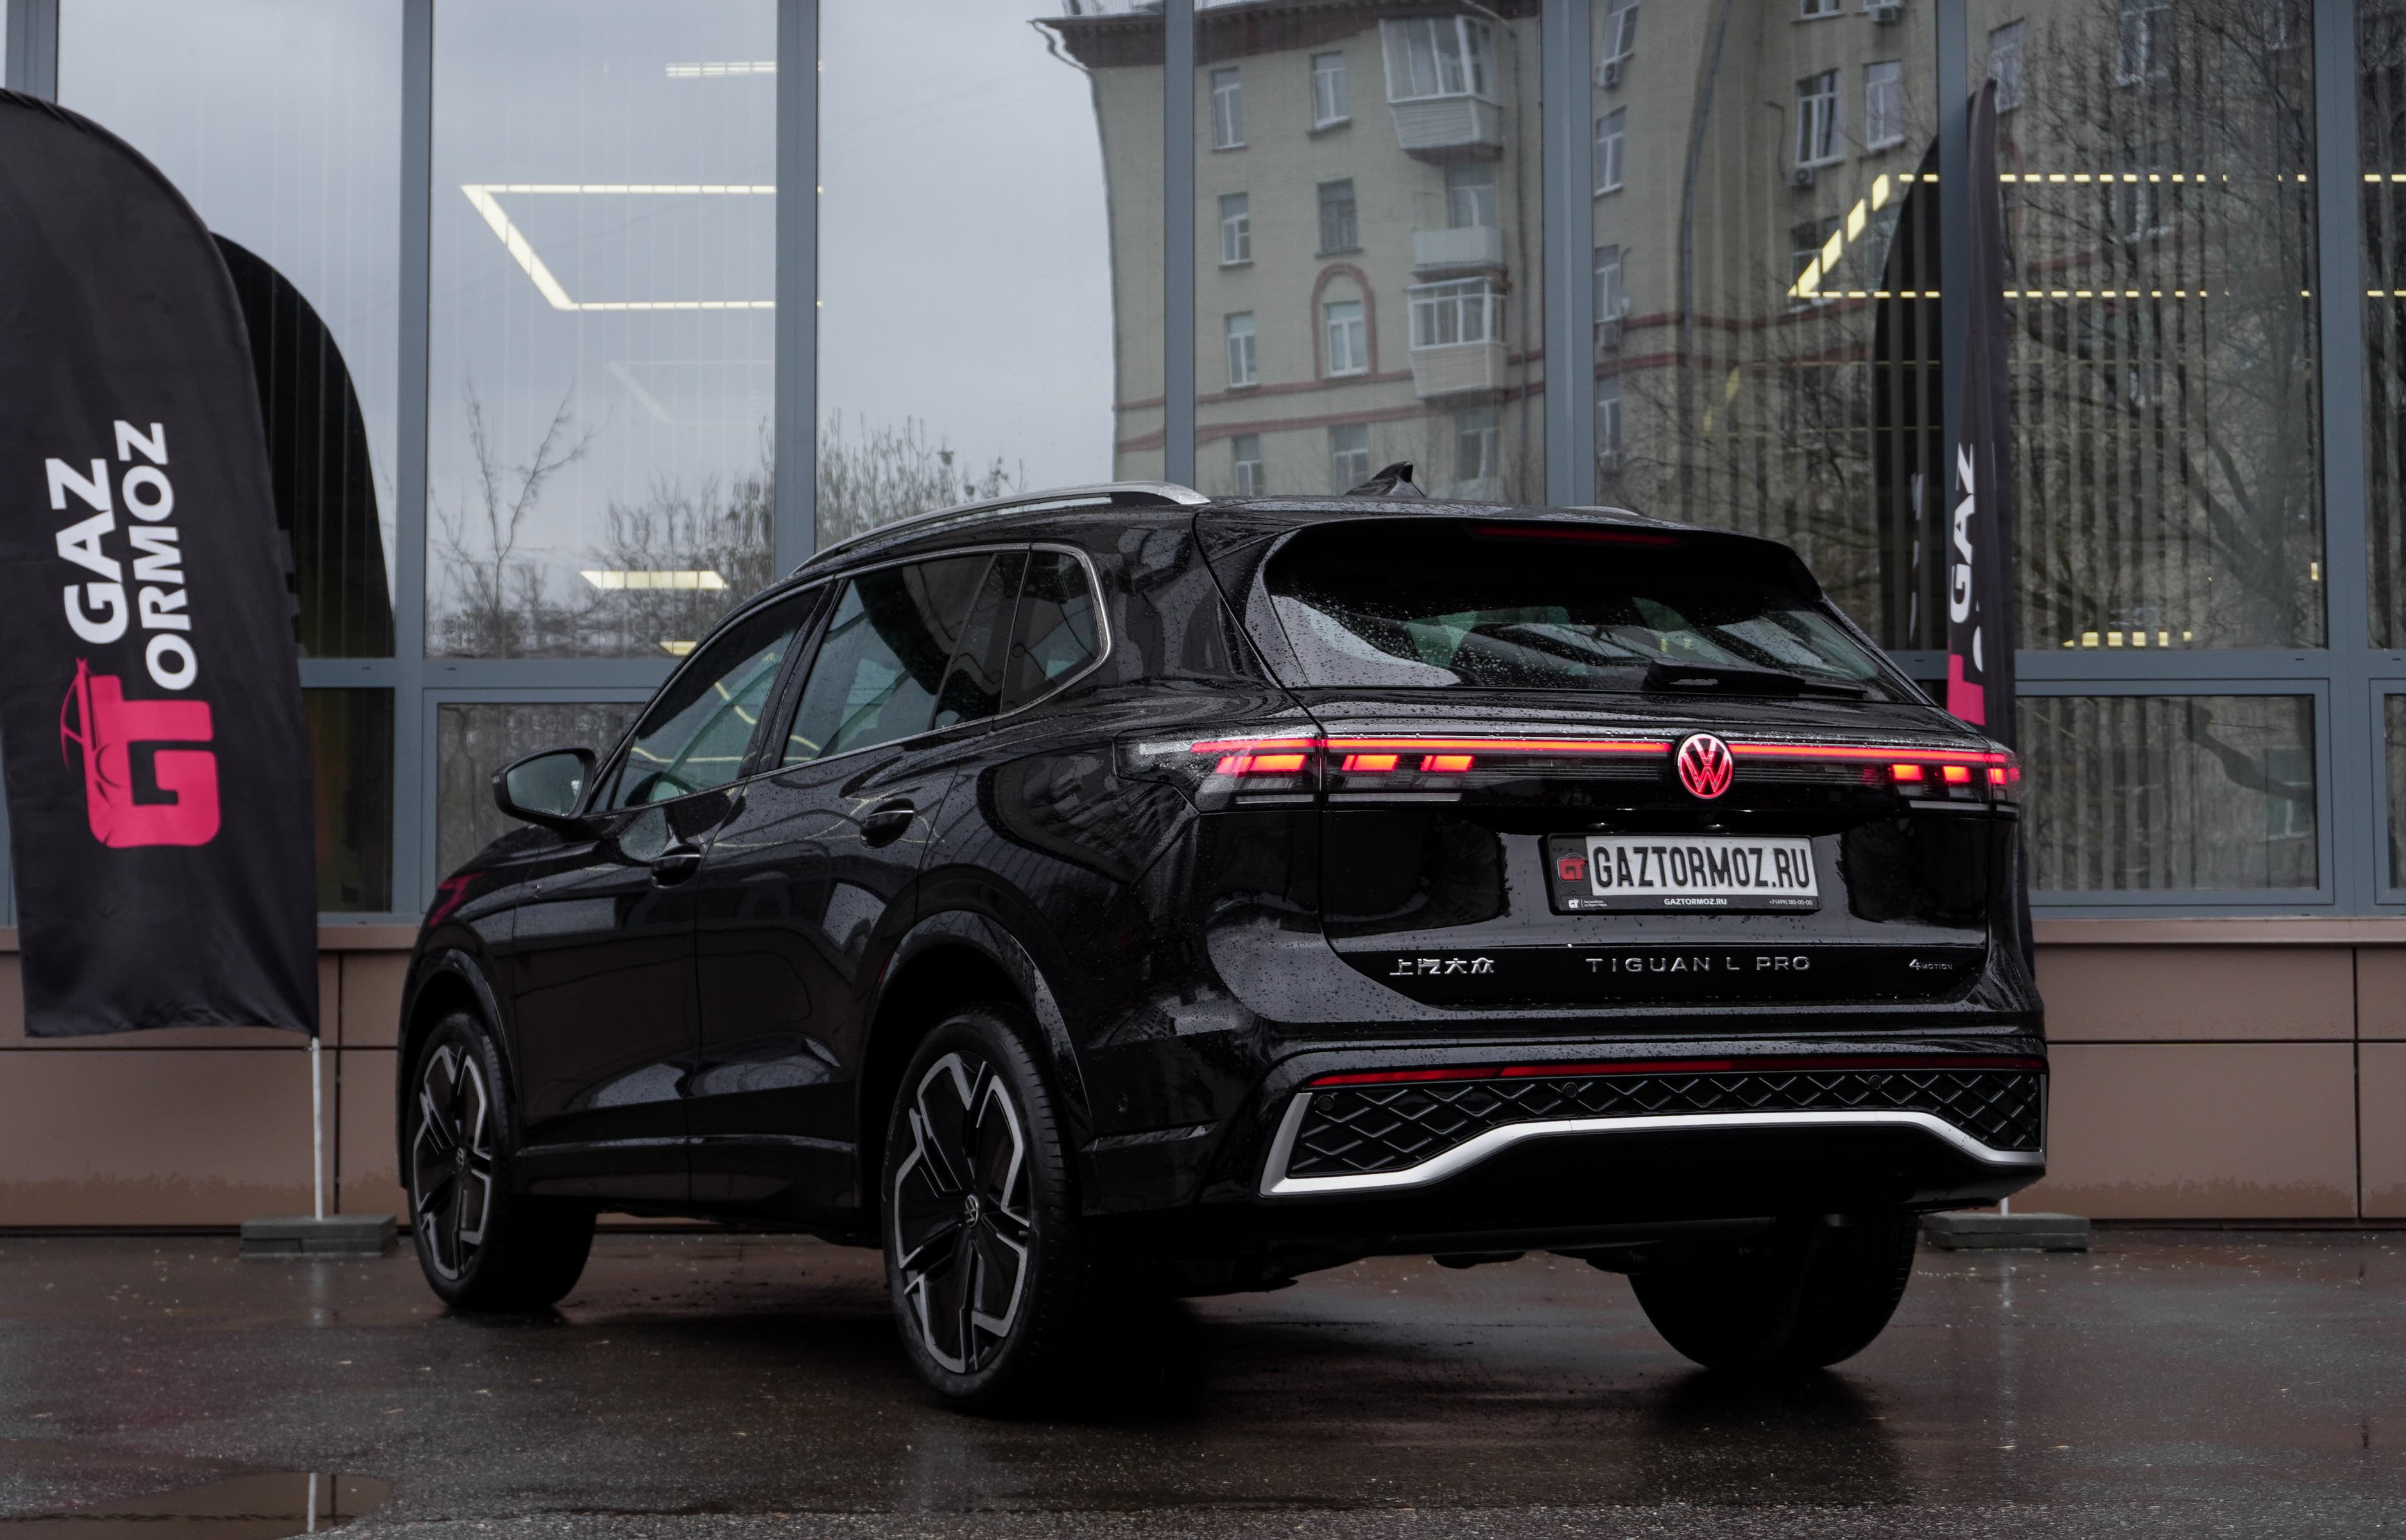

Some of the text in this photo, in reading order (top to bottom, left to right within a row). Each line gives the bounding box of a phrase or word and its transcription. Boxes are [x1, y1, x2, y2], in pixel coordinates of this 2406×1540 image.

[46, 458, 129, 644] GAZ
[1950, 442, 1975, 623] GAZ
[1679, 735, 1731, 796] VW
[1592, 845, 1810, 889] GAZTORMOZ.RU
[1586, 956, 1811, 972] TIGUAN L PRO
[1909, 959, 1953, 970] 4MOTION
